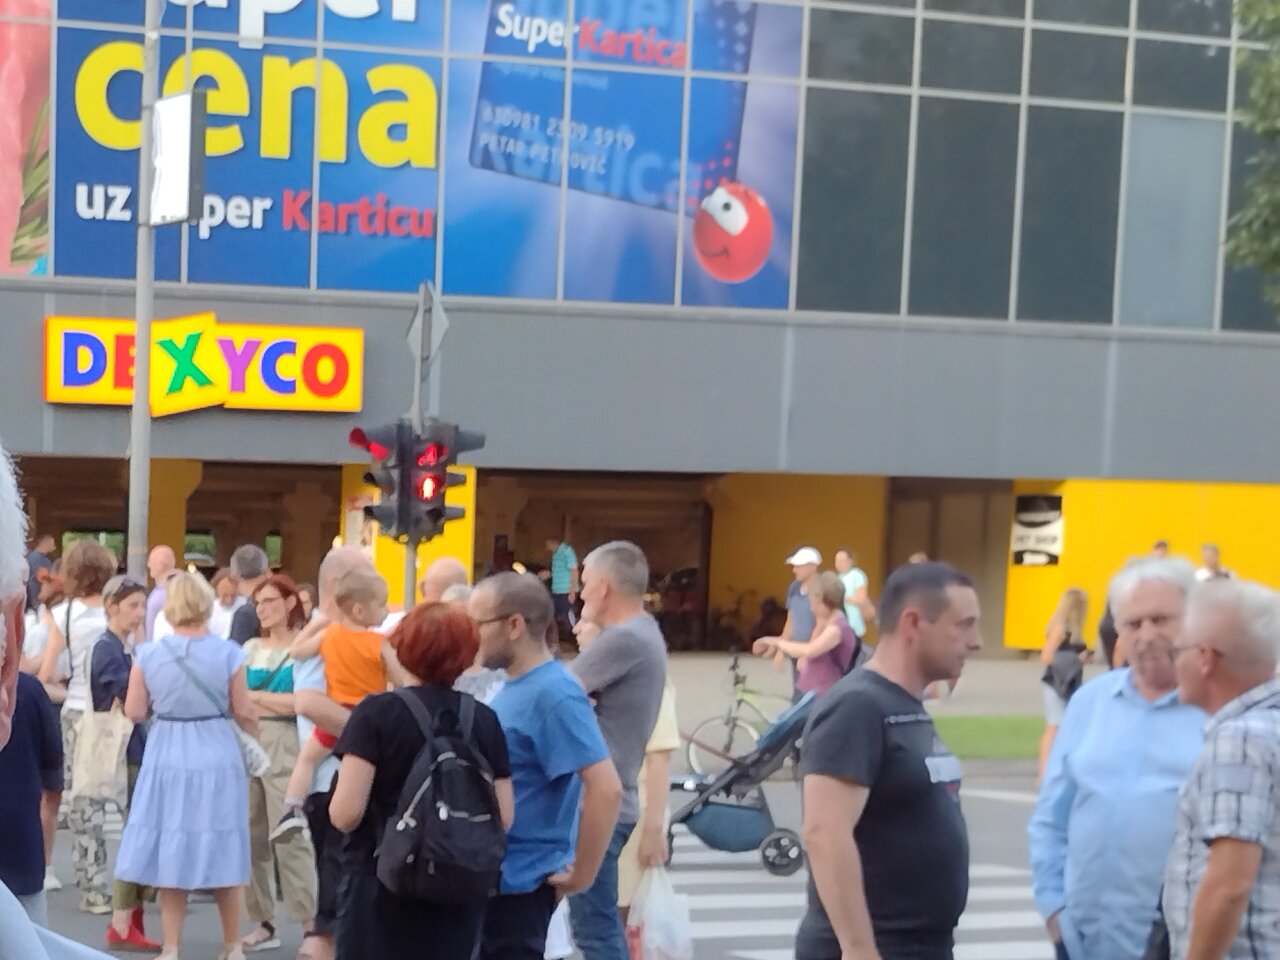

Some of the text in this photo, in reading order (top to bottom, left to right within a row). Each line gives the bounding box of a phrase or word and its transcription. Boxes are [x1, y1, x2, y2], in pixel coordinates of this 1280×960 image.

[75, 41, 438, 168] cena
[76, 183, 132, 221] uz
[282, 190, 435, 238] Karticu
[62, 331, 350, 399] DEXYCO
